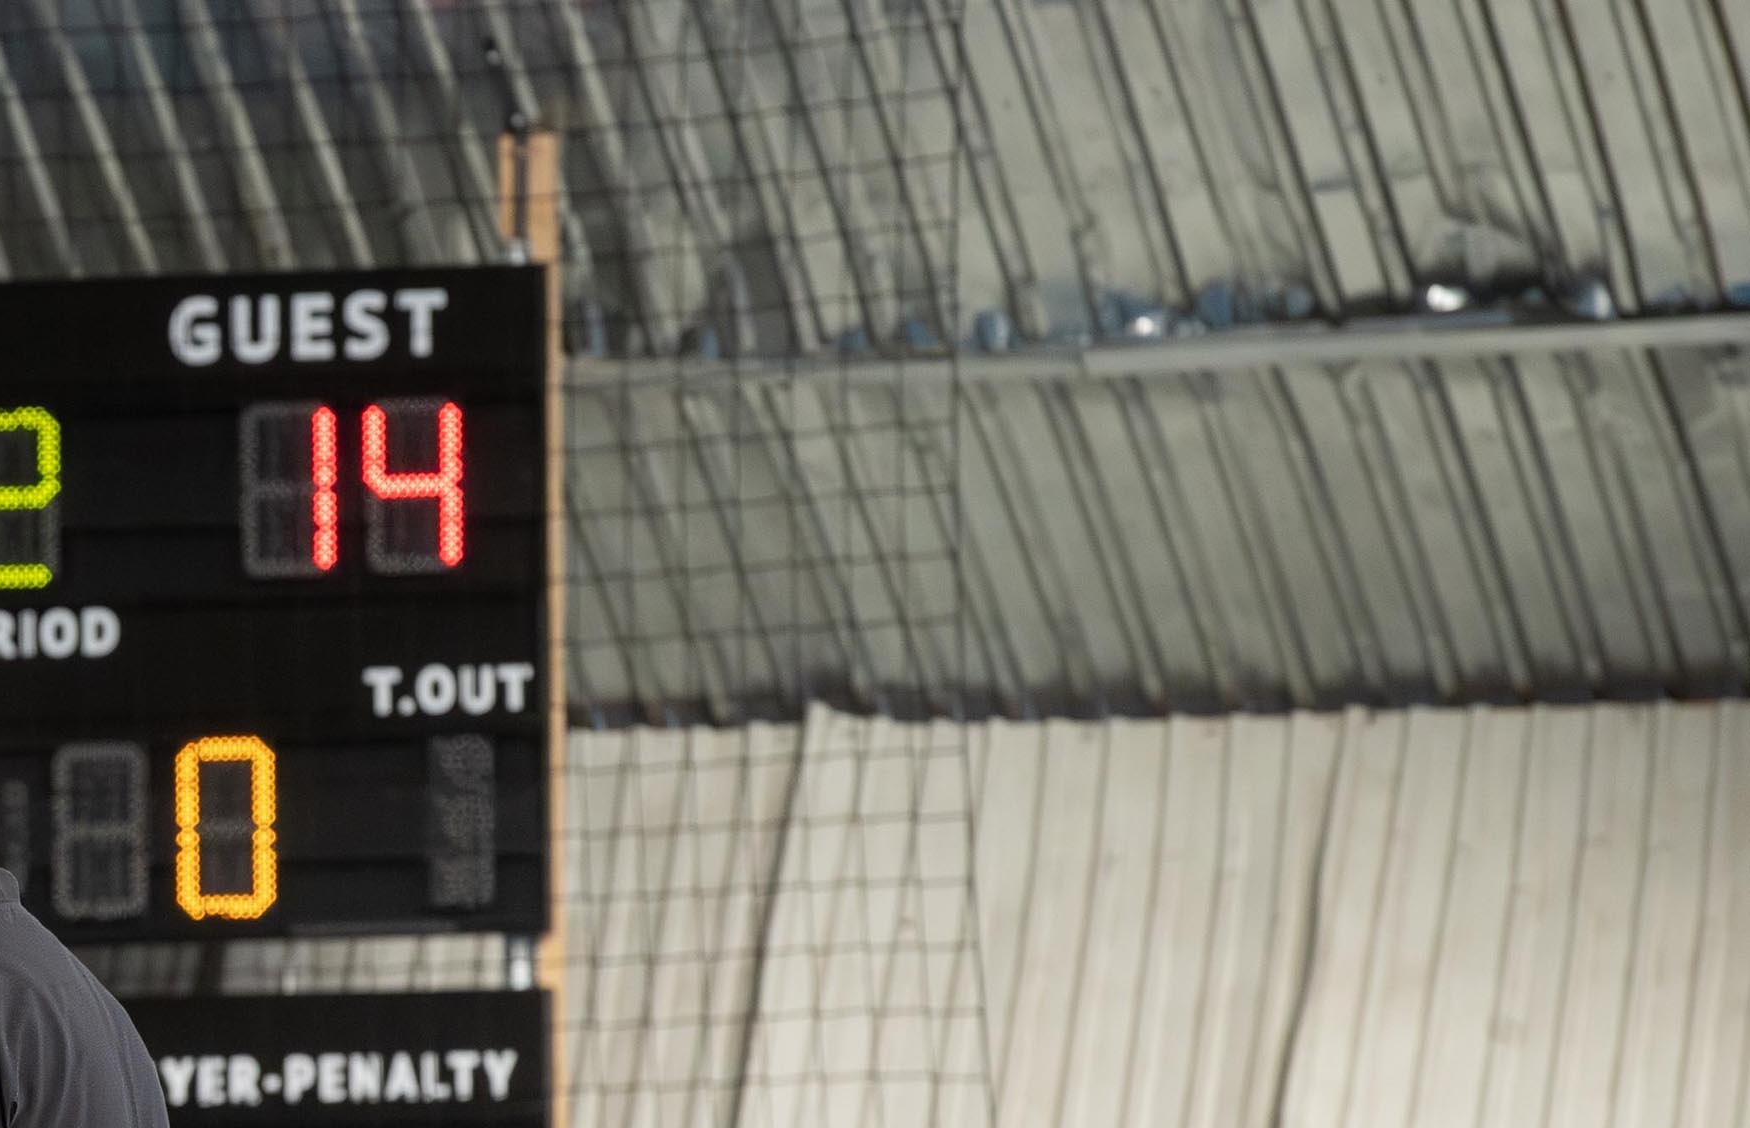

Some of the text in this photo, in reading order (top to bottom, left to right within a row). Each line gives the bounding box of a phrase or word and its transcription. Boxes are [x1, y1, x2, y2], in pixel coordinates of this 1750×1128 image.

[168, 287, 449, 367] GUEST
[310, 401, 465, 571] 14
[361, 661, 536, 719] T.OUT
[174, 735, 279, 921] 0
